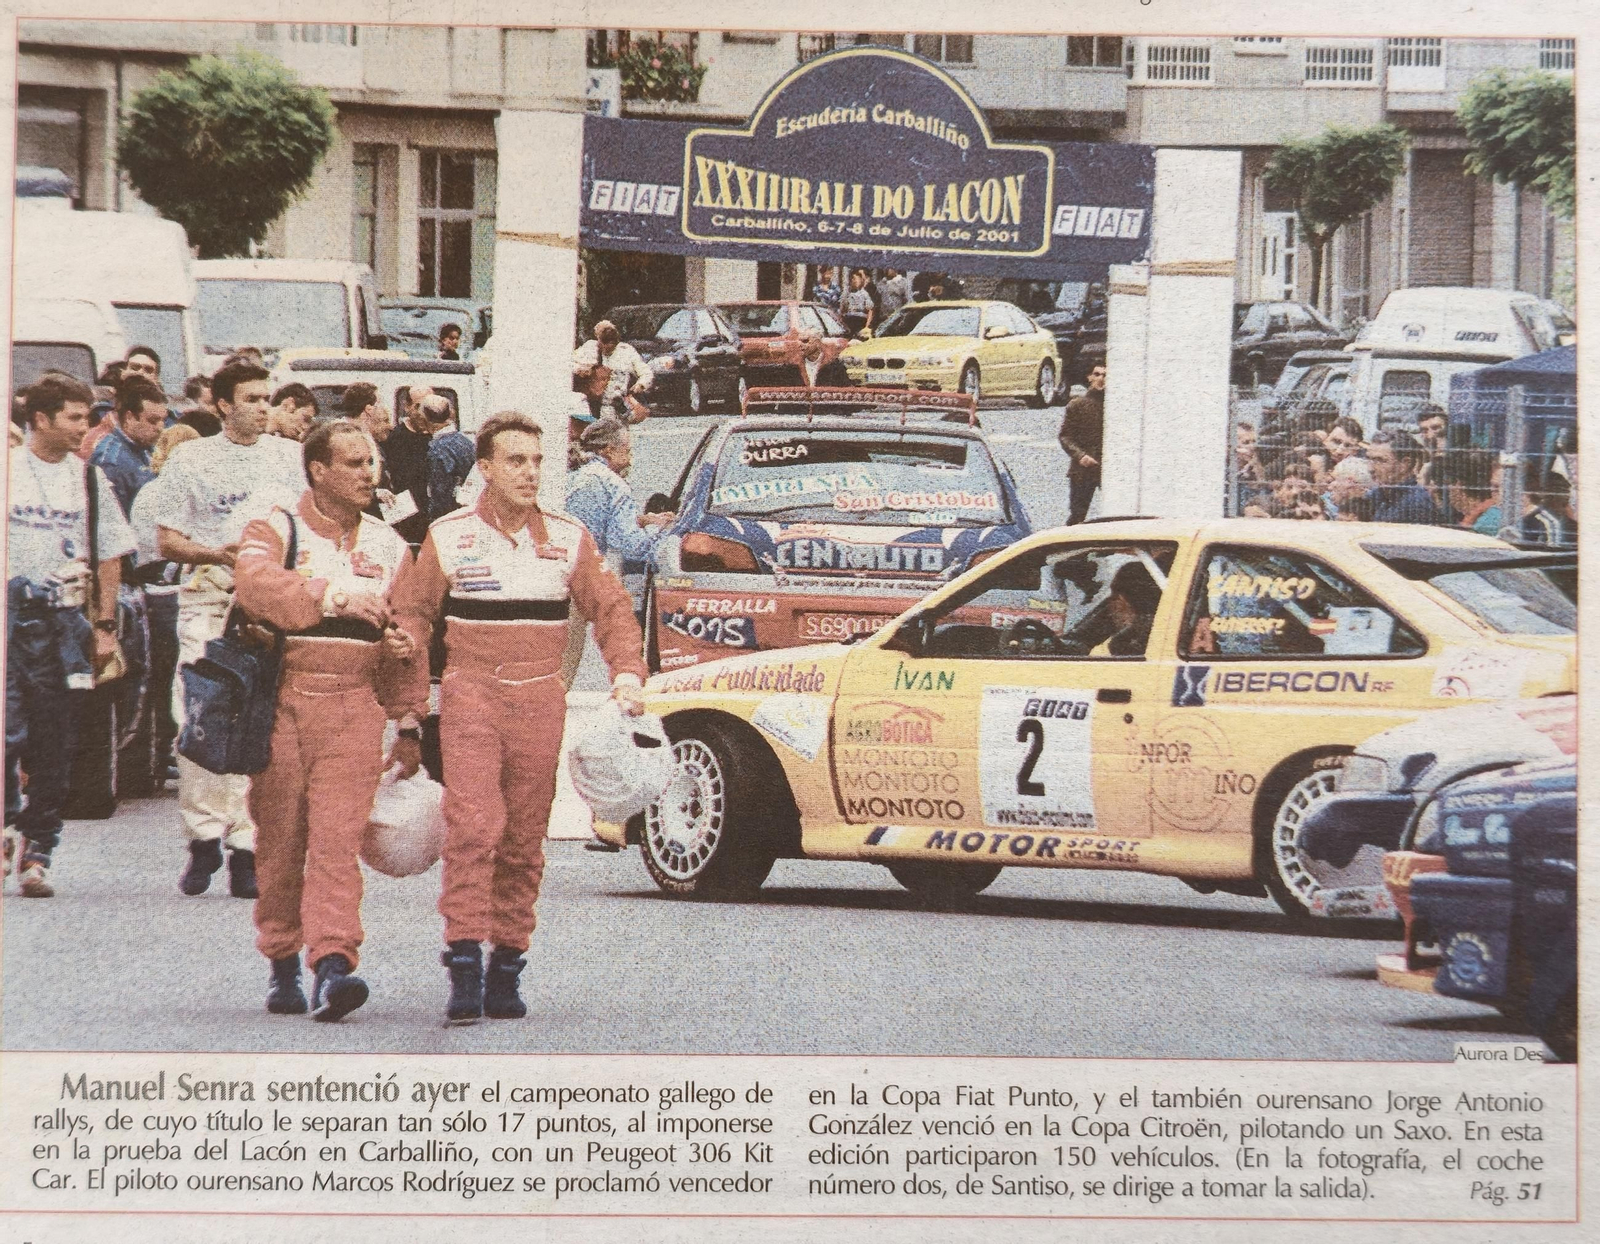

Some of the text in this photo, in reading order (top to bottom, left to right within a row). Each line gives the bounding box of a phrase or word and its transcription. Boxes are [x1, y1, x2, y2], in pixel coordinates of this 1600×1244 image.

[872, 103, 970, 149] Carballiño
[590, 180, 680, 216] FIAT
[871, 185, 915, 219] DO
[923, 174, 1026, 225] LACON
[711, 214, 1020, 243] Carballiño, 6-7-8 de Julio de 2001
[1053, 205, 1143, 239] FIAT
[835, 493, 882, 511] San
[685, 598, 778, 613] FERRALLA
[712, 663, 825, 693] Publicidade
[894, 661, 956, 691] IVAN
[1213, 671, 1370, 693] IBERCON
[843, 749, 959, 770] MONTOTO
[1016, 718, 1046, 796] 2
[844, 771, 961, 794] MONTOTO
[849, 797, 966, 820] MONTOTO
[923, 829, 1062, 859] MOTOR
[1065, 836, 1141, 853] SPORT
[1455, 1045, 1508, 1061] Aurora
[61, 1071, 774, 1112] Manuel Senra sentenció ayer el campeonato gallego de
[808, 1083, 1544, 1118] en la Copa Fiat Punto, y el también ourensano Jorge Antonio
[33, 1108, 774, 1142] rallys, de cuyo título le separan tan sólo 17 puntos, al imponerse
[809, 1112, 1544, 1146] González venció en la Copa Citroën, pilotando un Saxo. En esta
[33, 1137, 774, 1171] en la prueba del Lacón en Carballiño, con un Peugeot 306 Kit
[808, 1143, 1545, 1177] edición participaron 150 vehículos. (En la fotografía, el coche
[32, 1168, 774, 1201] Car. El piloto ourensano Marcos Rodríguez se proclamó vencedor
[808, 1173, 1376, 1206] número dos, de Santiso, se dirige a tomar la salida).
[1471, 1181, 1543, 1207] Pág. 51
